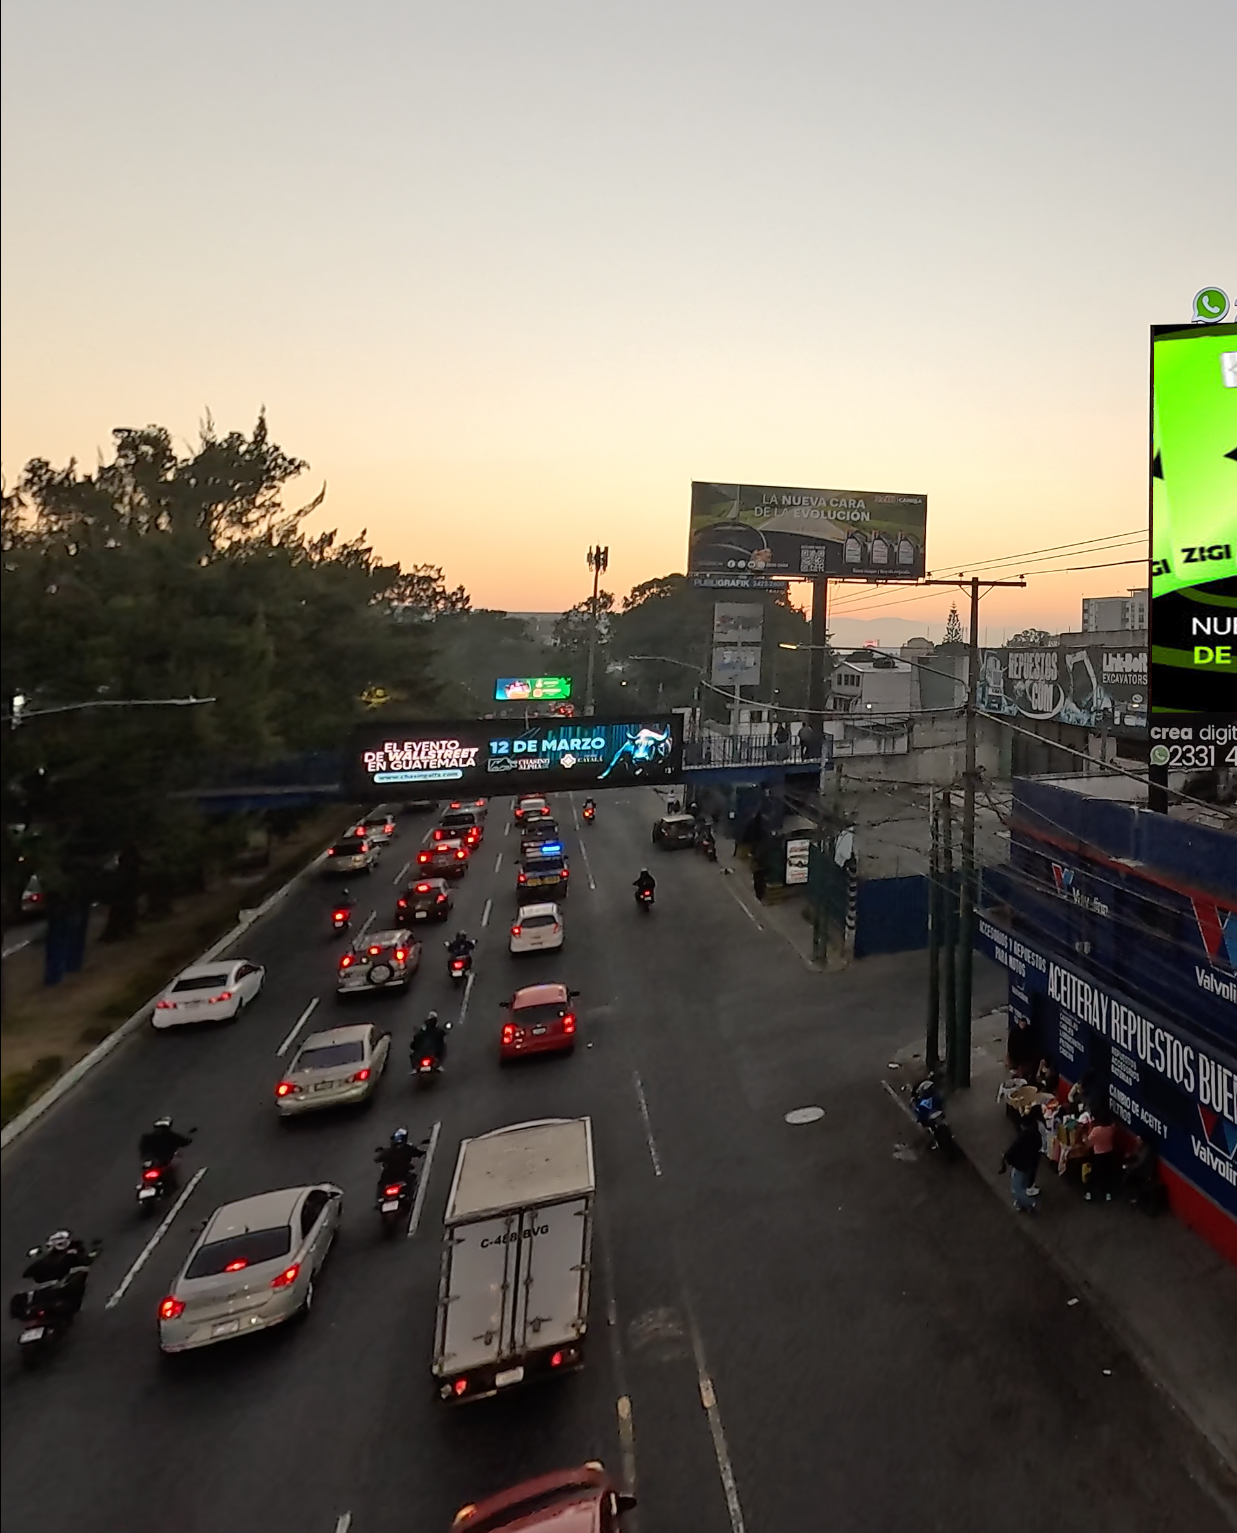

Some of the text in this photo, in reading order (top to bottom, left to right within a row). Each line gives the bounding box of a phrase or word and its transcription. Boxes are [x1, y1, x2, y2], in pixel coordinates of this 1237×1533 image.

[762, 493, 778, 505] LA
[781, 495, 827, 508] NUEVA
[829, 498, 866, 510] CARA
[754, 506, 771, 518] DE
[793, 507, 871, 522] EVOLUCIÓN
[1181, 544, 1232, 564] ZIGI
[1193, 645, 1232, 665] DE
[1008, 652, 1058, 681] REPUESTOS
[1102, 673, 1149, 686] EXCAVATORS
[1150, 726, 1193, 741] crea
[384, 740, 460, 753] EL EVENTO
[489, 736, 606, 754] 12 DE MARZO
[364, 747, 479, 763] DE WALLSTREET
[1169, 746, 1215, 767] 2331
[368, 757, 476, 772] EN GUATEMALA
[1110, 999, 1195, 1093] REPUESTOS
